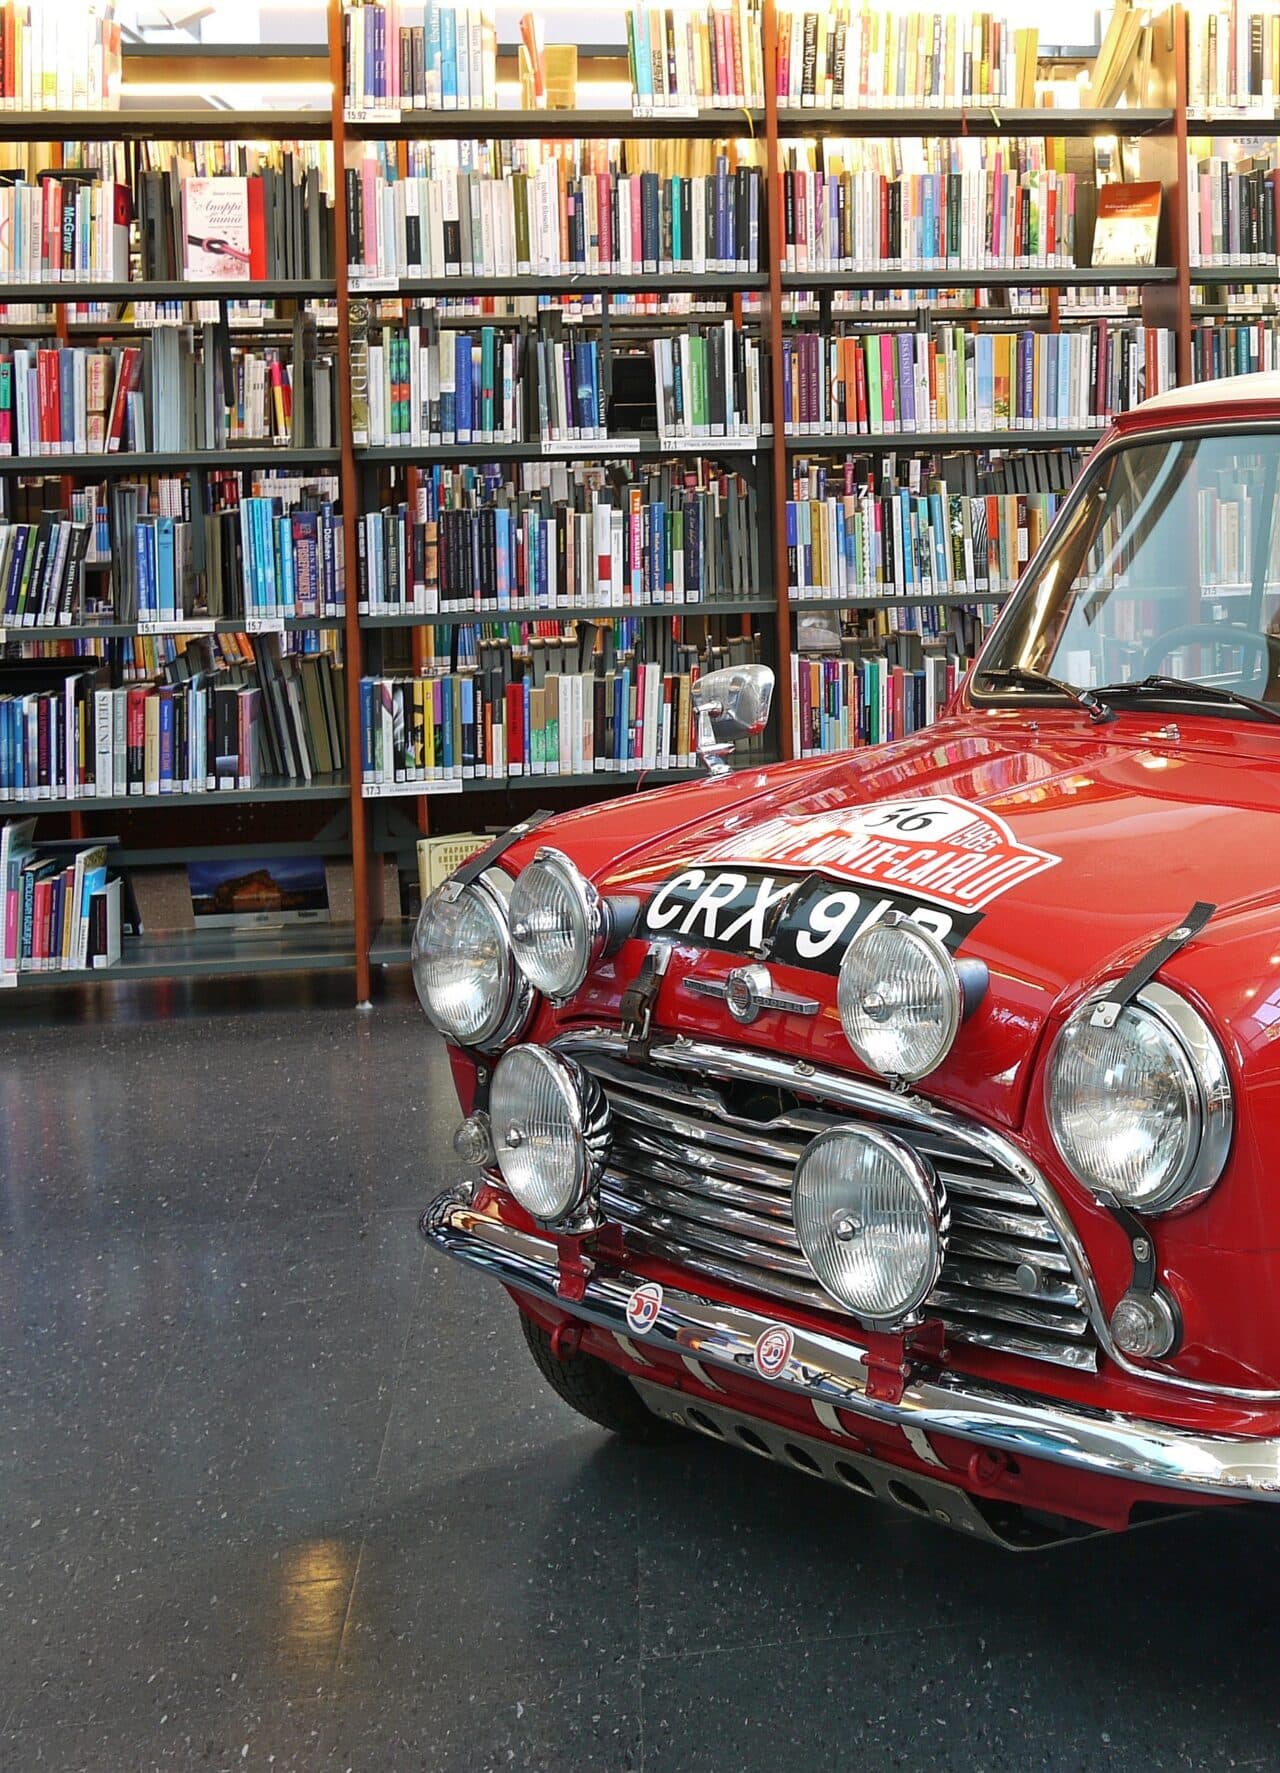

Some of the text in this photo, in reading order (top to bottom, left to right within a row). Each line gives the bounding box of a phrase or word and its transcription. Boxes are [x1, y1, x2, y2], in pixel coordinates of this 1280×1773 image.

[805, 15, 818, 44] Wayne
[804, 56, 816, 79] Dyer
[834, 60, 844, 80] Dyer
[346, 111, 367, 121] 15.92
[63, 207, 75, 253] McGraw
[544, 443, 552, 453] 17
[664, 440, 678, 450] 17.1
[141, 623, 156, 633] 15.1
[247, 621, 262, 631] 15.7
[99, 696, 111, 743] SIELUN
[366, 786, 381, 796] 17.3
[942, 821, 1005, 854] 1965
[646, 869, 802, 948] CRX
[754, 996, 803, 1012] COOPER
